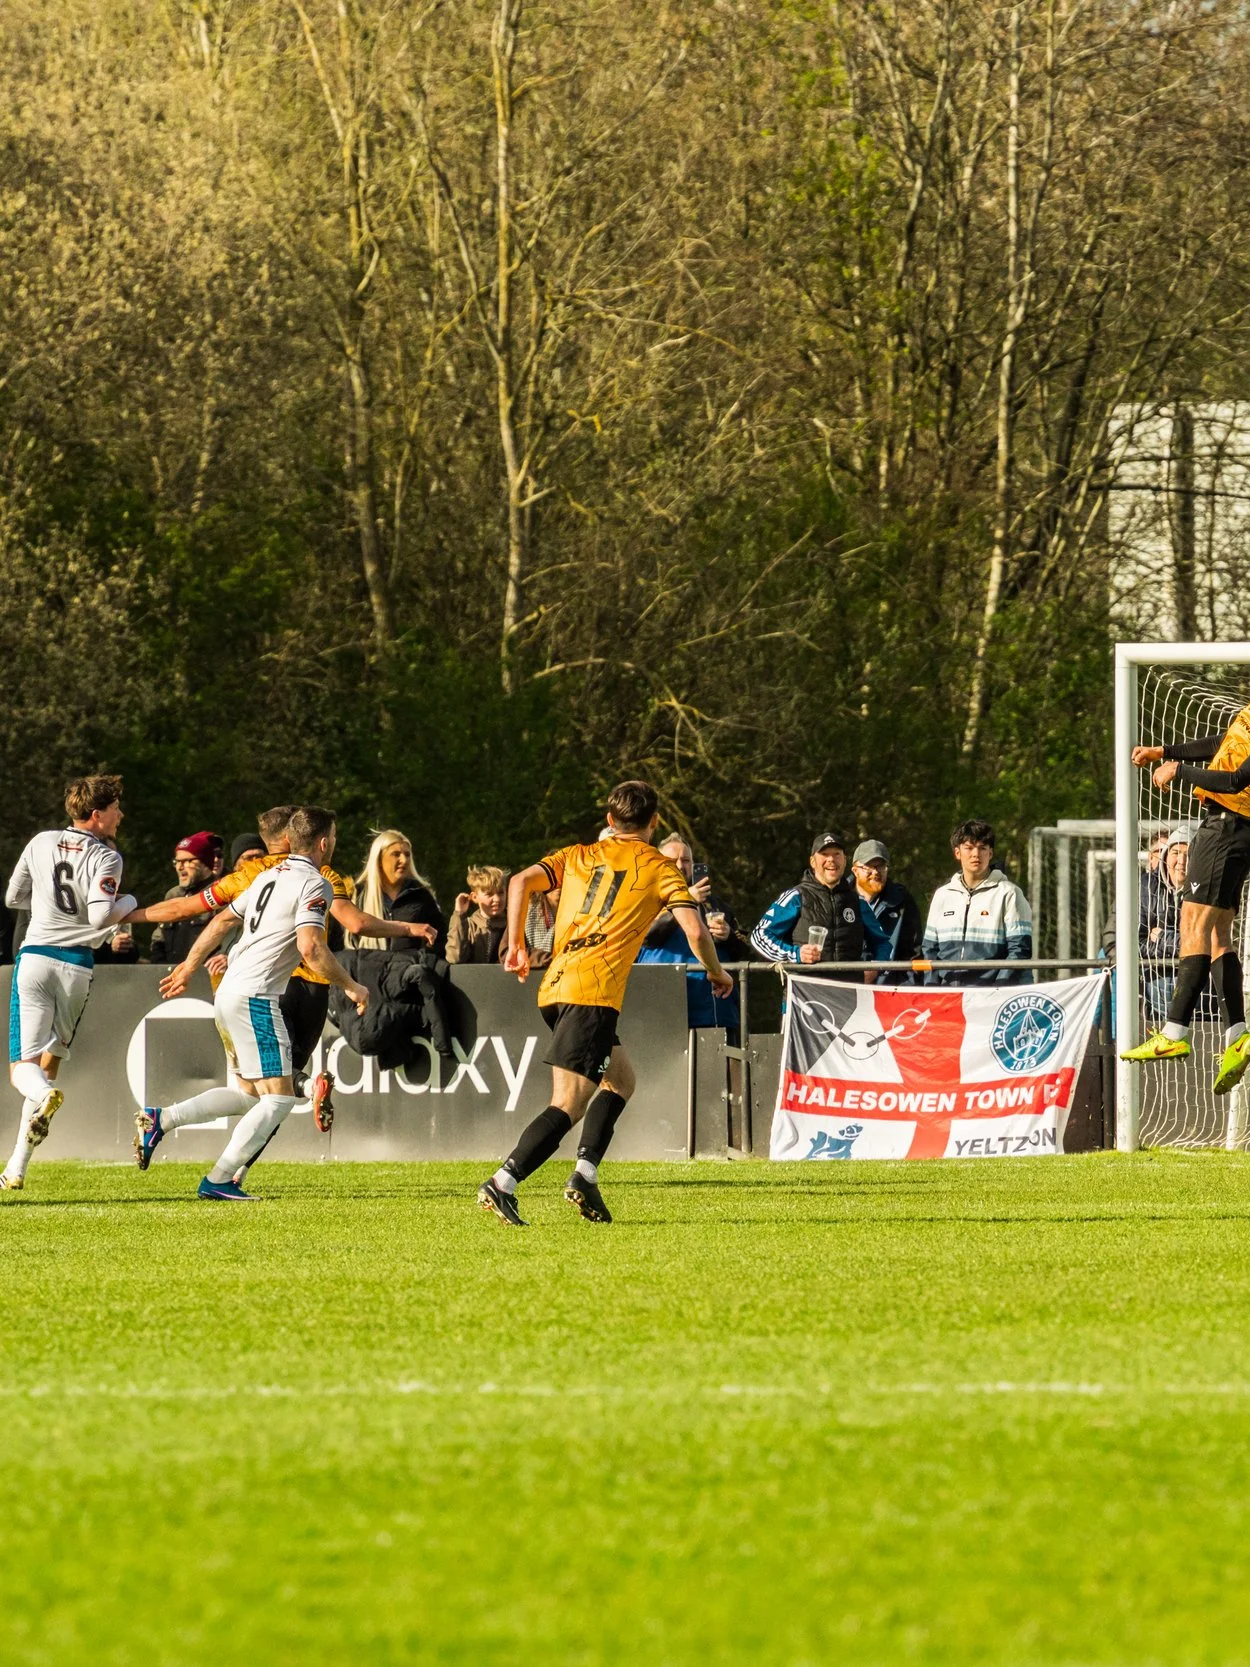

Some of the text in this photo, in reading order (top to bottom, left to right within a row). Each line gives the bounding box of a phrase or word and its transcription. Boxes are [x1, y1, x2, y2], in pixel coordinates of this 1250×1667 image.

[53, 860, 78, 915] 6
[249, 880, 276, 934] 9
[579, 864, 628, 918] 11
[994, 996, 1063, 1050] HALESOWEN TOWN
[1010, 1057, 1037, 1070] 1873
[786, 1082, 957, 1113] HALESOWEN
[964, 1085, 1035, 1110] TOWN
